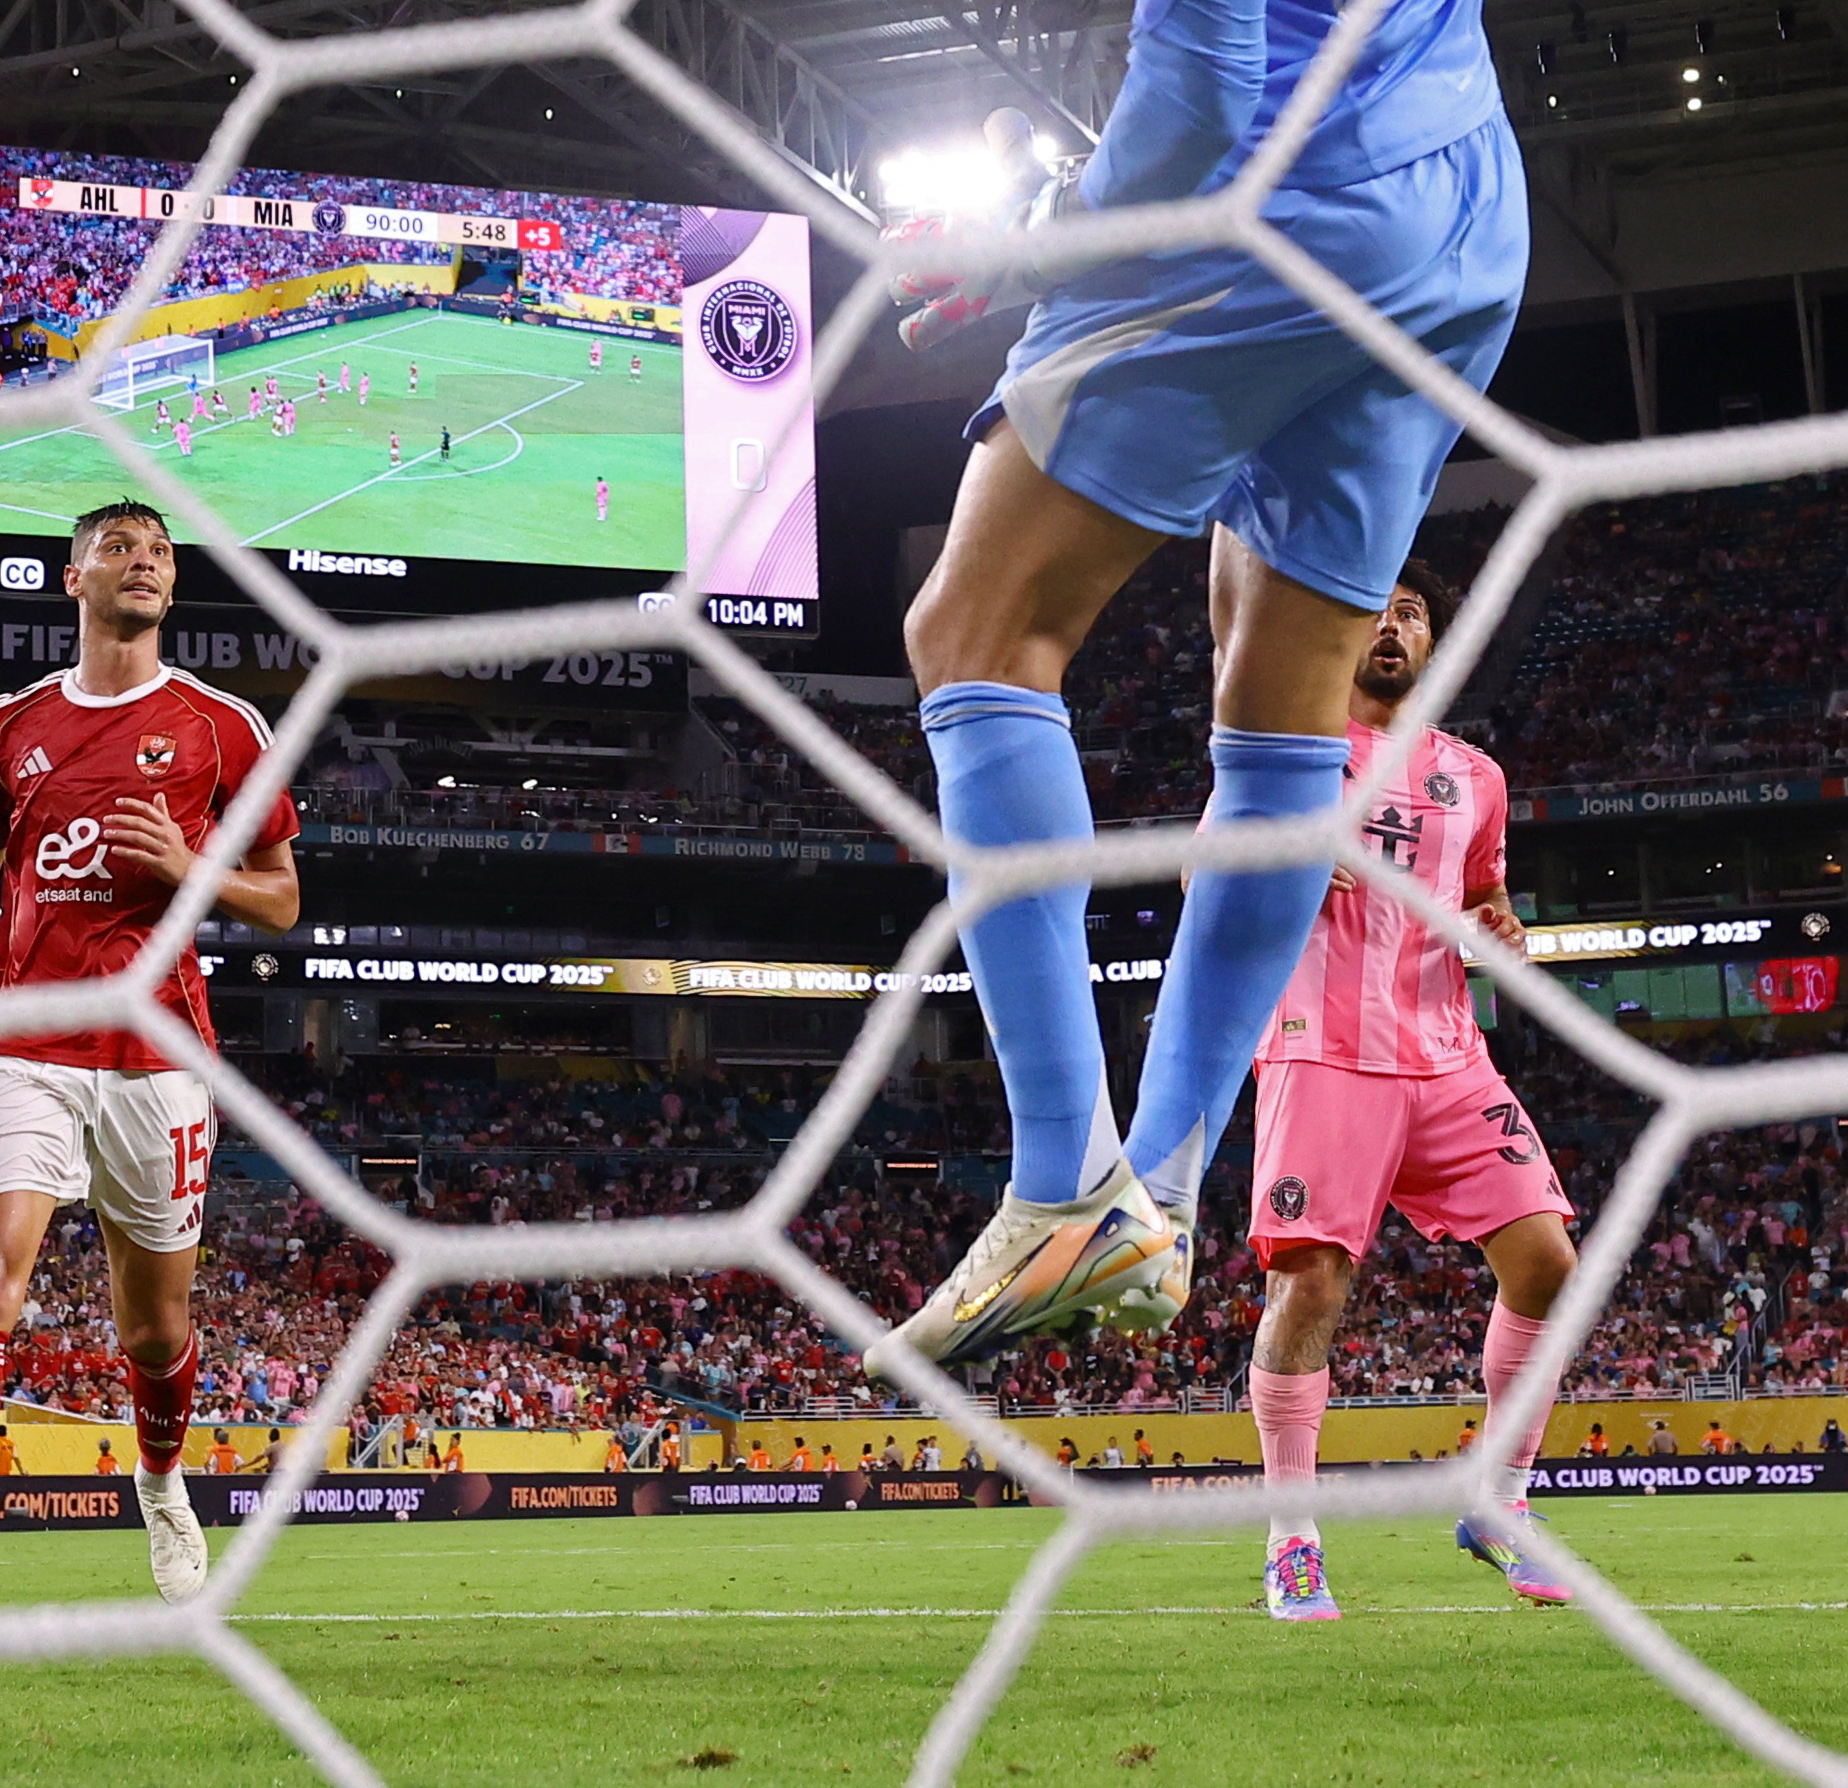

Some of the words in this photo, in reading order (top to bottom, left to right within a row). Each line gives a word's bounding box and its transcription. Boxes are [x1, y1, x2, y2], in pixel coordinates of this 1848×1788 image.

[80, 186, 118, 213] AHL
[161, 193, 174, 217] 0
[254, 200, 294, 227] MIA
[366, 213, 423, 234] 90:00
[462, 221, 506, 241] 5:48
[525, 227, 551, 246] +5
[728, 304, 766, 317] MIAMI
[730, 437, 769, 493] 0
[4, 562, 41, 586] CC
[289, 549, 407, 577] Hisense
[708, 599, 768, 626] 10:04
[774, 602, 804, 627] PM
[161, 632, 241, 668] LUB
[1578, 797, 1633, 816] JOHN
[1640, 787, 1752, 811] OFFERDAHL
[1759, 782, 1790, 803] 56
[330, 825, 370, 845] BOB
[376, 827, 510, 850] KUECHENBERG
[520, 832, 550, 851] 67
[674, 838, 773, 857] RICHMOND
[779, 841, 831, 860] WEBB
[843, 844, 866, 861] 78
[83, 888, 113, 903] and
[1559, 929, 1646, 953] WORLD
[1649, 924, 1698, 948] CUP
[305, 958, 354, 979] FIFA
[356, 960, 414, 981] CLUB
[417, 961, 499, 983] WORLD
[501, 963, 546, 984] CUP
[689, 968, 736, 988] FIFA
[738, 969, 792, 990] CLUB
[795, 970, 871, 992] WORLD
[1105, 959, 1163, 982] CLUB
[169, 1119, 211, 1202] 15
[1555, 1468, 1614, 1488] CLUB
[1618, 1466, 1702, 1487] WORLD
[1705, 1465, 1752, 1486] CUP
[229, 1489, 260, 1515] FIFA
[303, 1489, 354, 1513] WORLD
[356, 1489, 384, 1512] CUP
[511, 1486, 617, 1509] FIFA.COM/TICKETS
[690, 1486, 713, 1506] FIFA
[714, 1485, 740, 1505] CLUB
[741, 1485, 776, 1505] WORLD
[777, 1485, 796, 1504] CUP
[881, 1481, 960, 1501] FIFA.COM/TICKETS
